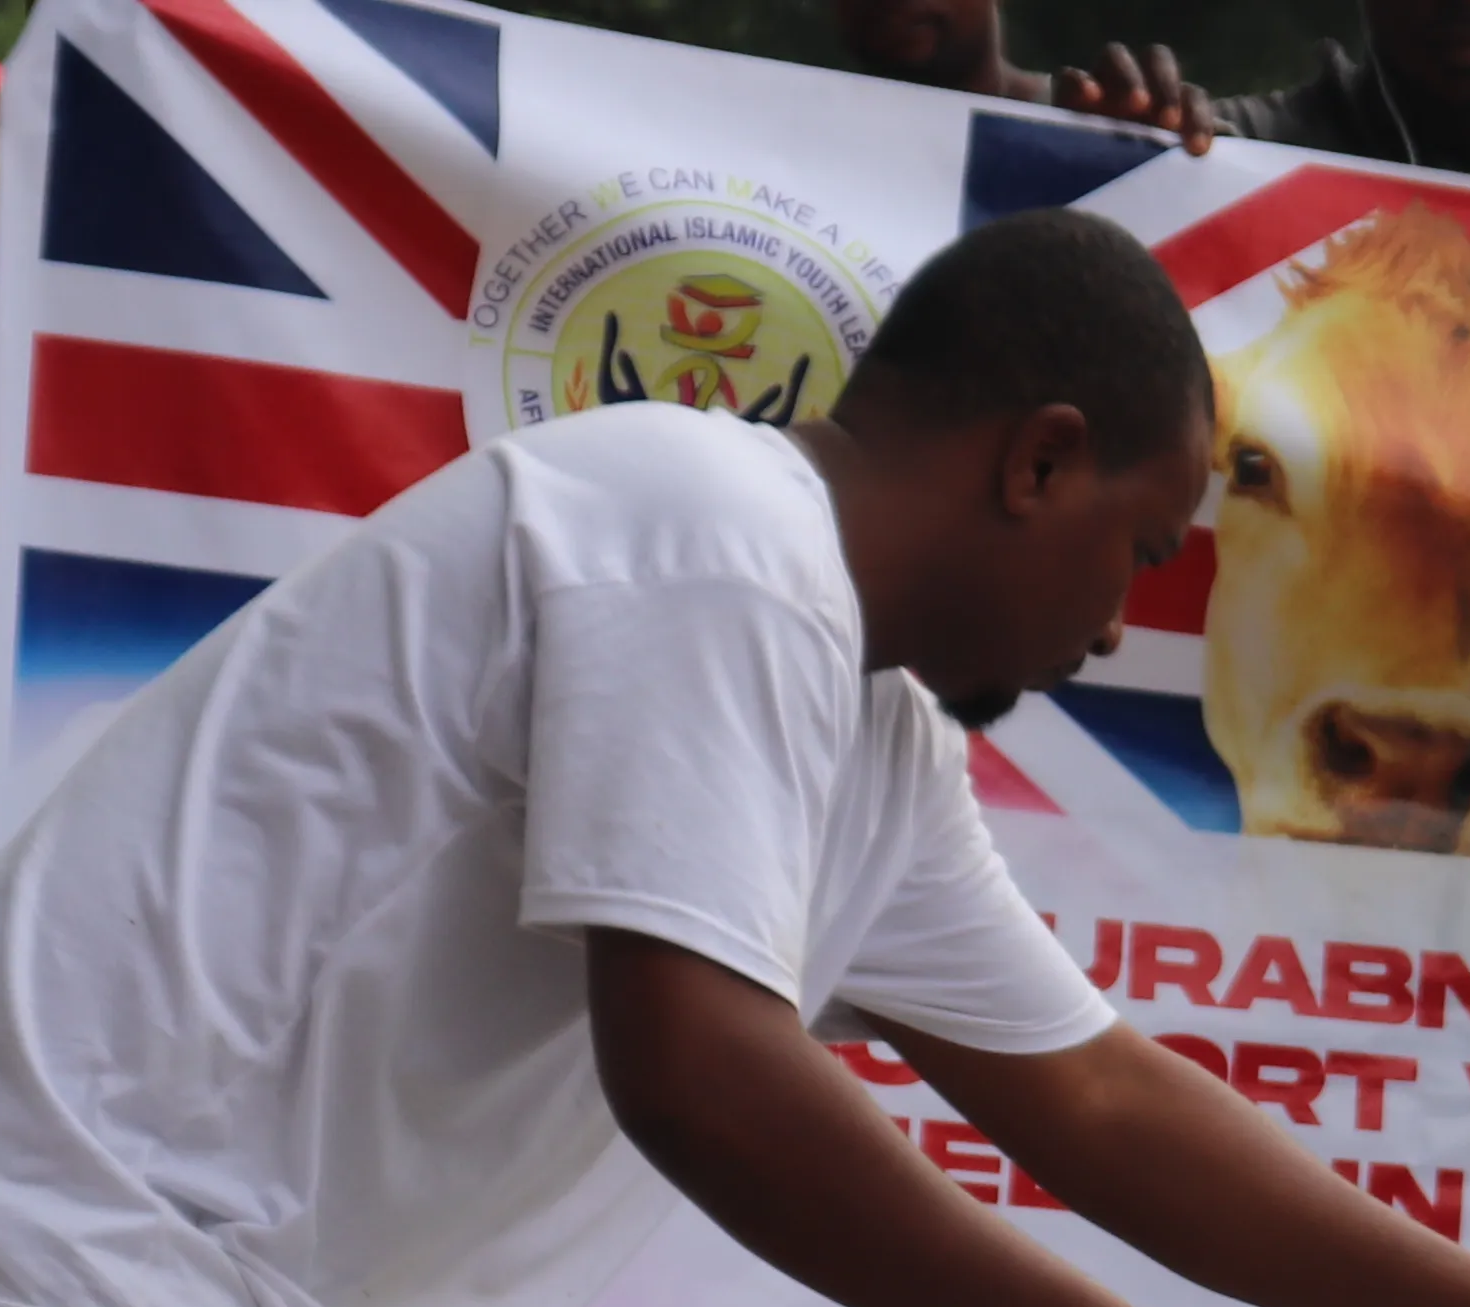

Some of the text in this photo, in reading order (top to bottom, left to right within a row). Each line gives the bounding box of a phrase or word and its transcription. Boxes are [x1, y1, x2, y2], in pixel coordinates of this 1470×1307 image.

[470, 199, 587, 346] TOGETHER
[590, 170, 643, 211] WE
[648, 167, 714, 193] CAN
[727, 175, 816, 227] MAKE
[817, 222, 841, 246] A
[529, 219, 678, 333] INTERNATIONAL
[685, 217, 781, 258] ISLAMIC
[785, 247, 849, 316] YOUTH
